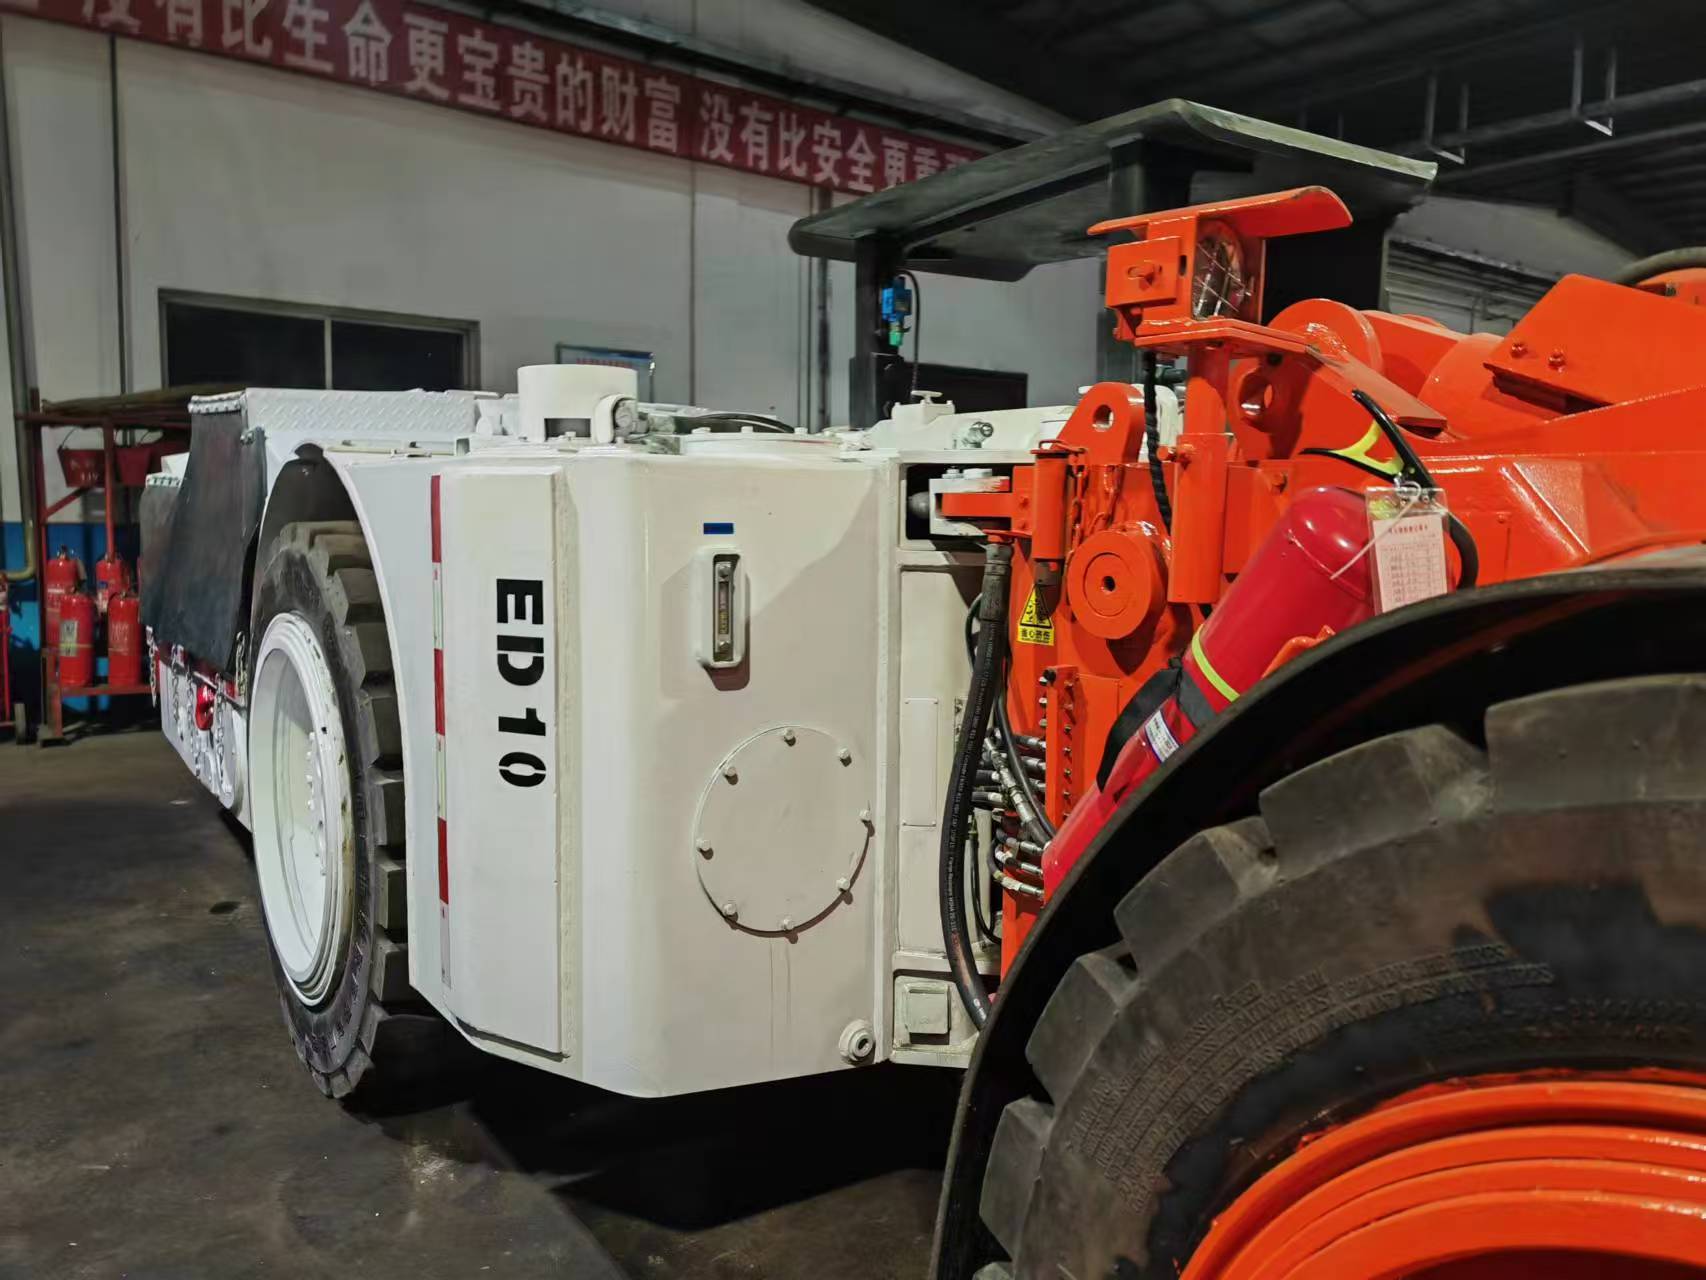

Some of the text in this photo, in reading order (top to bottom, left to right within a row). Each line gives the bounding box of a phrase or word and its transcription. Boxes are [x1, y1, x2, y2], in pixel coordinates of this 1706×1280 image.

[701, 90, 973, 193] 没有比安全更重
